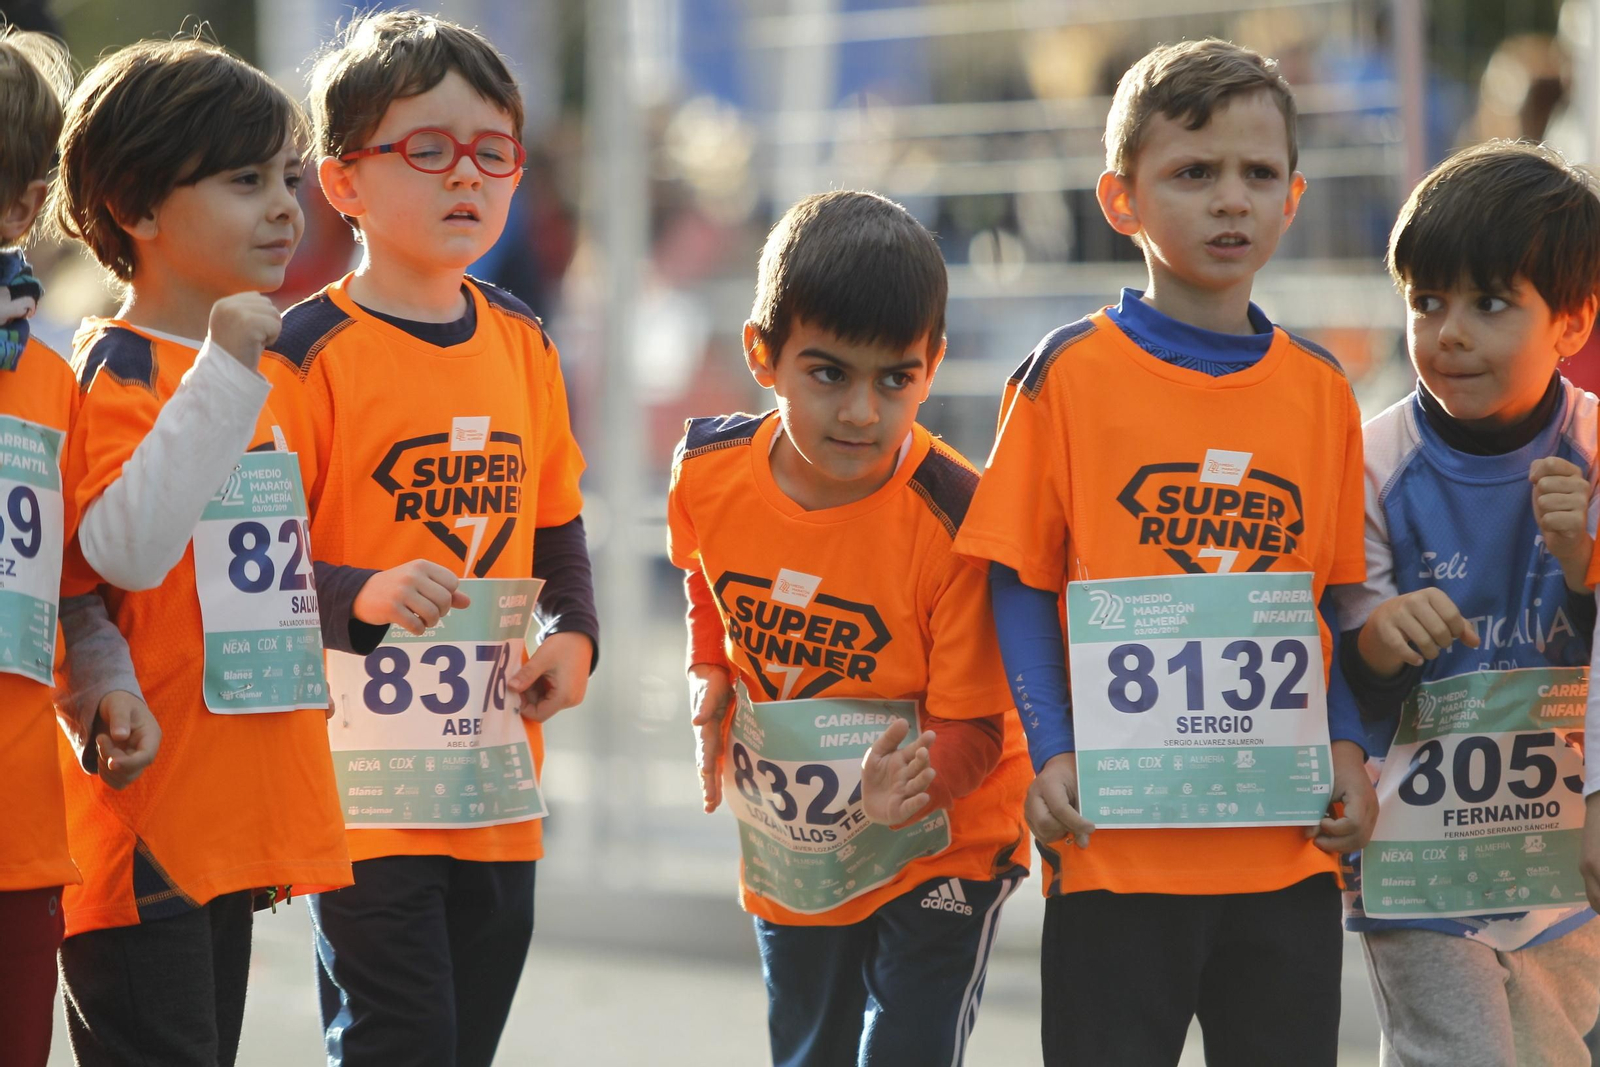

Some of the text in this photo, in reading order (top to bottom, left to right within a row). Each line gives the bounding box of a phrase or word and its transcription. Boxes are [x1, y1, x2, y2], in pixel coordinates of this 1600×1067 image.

[249, 469, 282, 479] MEDIO
[411, 454, 519, 488] SUPER
[1156, 485, 1285, 521] SUPER
[0, 486, 42, 559] 9
[1418, 550, 1468, 580] Seli
[1132, 593, 1172, 604] MEDIO
[1133, 601, 1195, 616] MARATÓN
[735, 595, 860, 651] SUPER
[1134, 613, 1189, 628] ALMERÍA
[1134, 626, 1180, 636] 03/02/2019
[222, 640, 251, 654] NEXA
[257, 637, 279, 651] CDX
[729, 615, 877, 683] RUNNER
[224, 670, 253, 680] Blanes
[363, 642, 510, 715] 8378
[1107, 638, 1309, 714] 8132
[1015, 673, 1040, 729] KIPSTA
[1442, 689, 1468, 703] MEDIO
[1441, 697, 1486, 715] MARATÓN
[1176, 715, 1253, 734] SERGIO
[1439, 709, 1479, 725] ALMERÍA
[1164, 738, 1264, 747] SERGIO ALVAREZ SALMERON
[348, 758, 382, 772] NEXA
[389, 756, 415, 770] CDX
[1097, 754, 1226, 771] NEXA CDX ALMERÍA
[348, 787, 384, 796] Blanes
[1098, 786, 1133, 796] Blanes
[360, 806, 394, 816] cajamar
[1112, 806, 1144, 816] cajamar
[1443, 800, 1560, 827] FERNANDO
[1444, 821, 1560, 839] FERNANDO SERRANO SÁNCHEZ
[1381, 840, 1511, 863] NEXA CDX ALMERÍA
[1381, 877, 1416, 887] Blanes
[921, 897, 973, 916] adidas
[1394, 896, 1427, 906] cajamar
